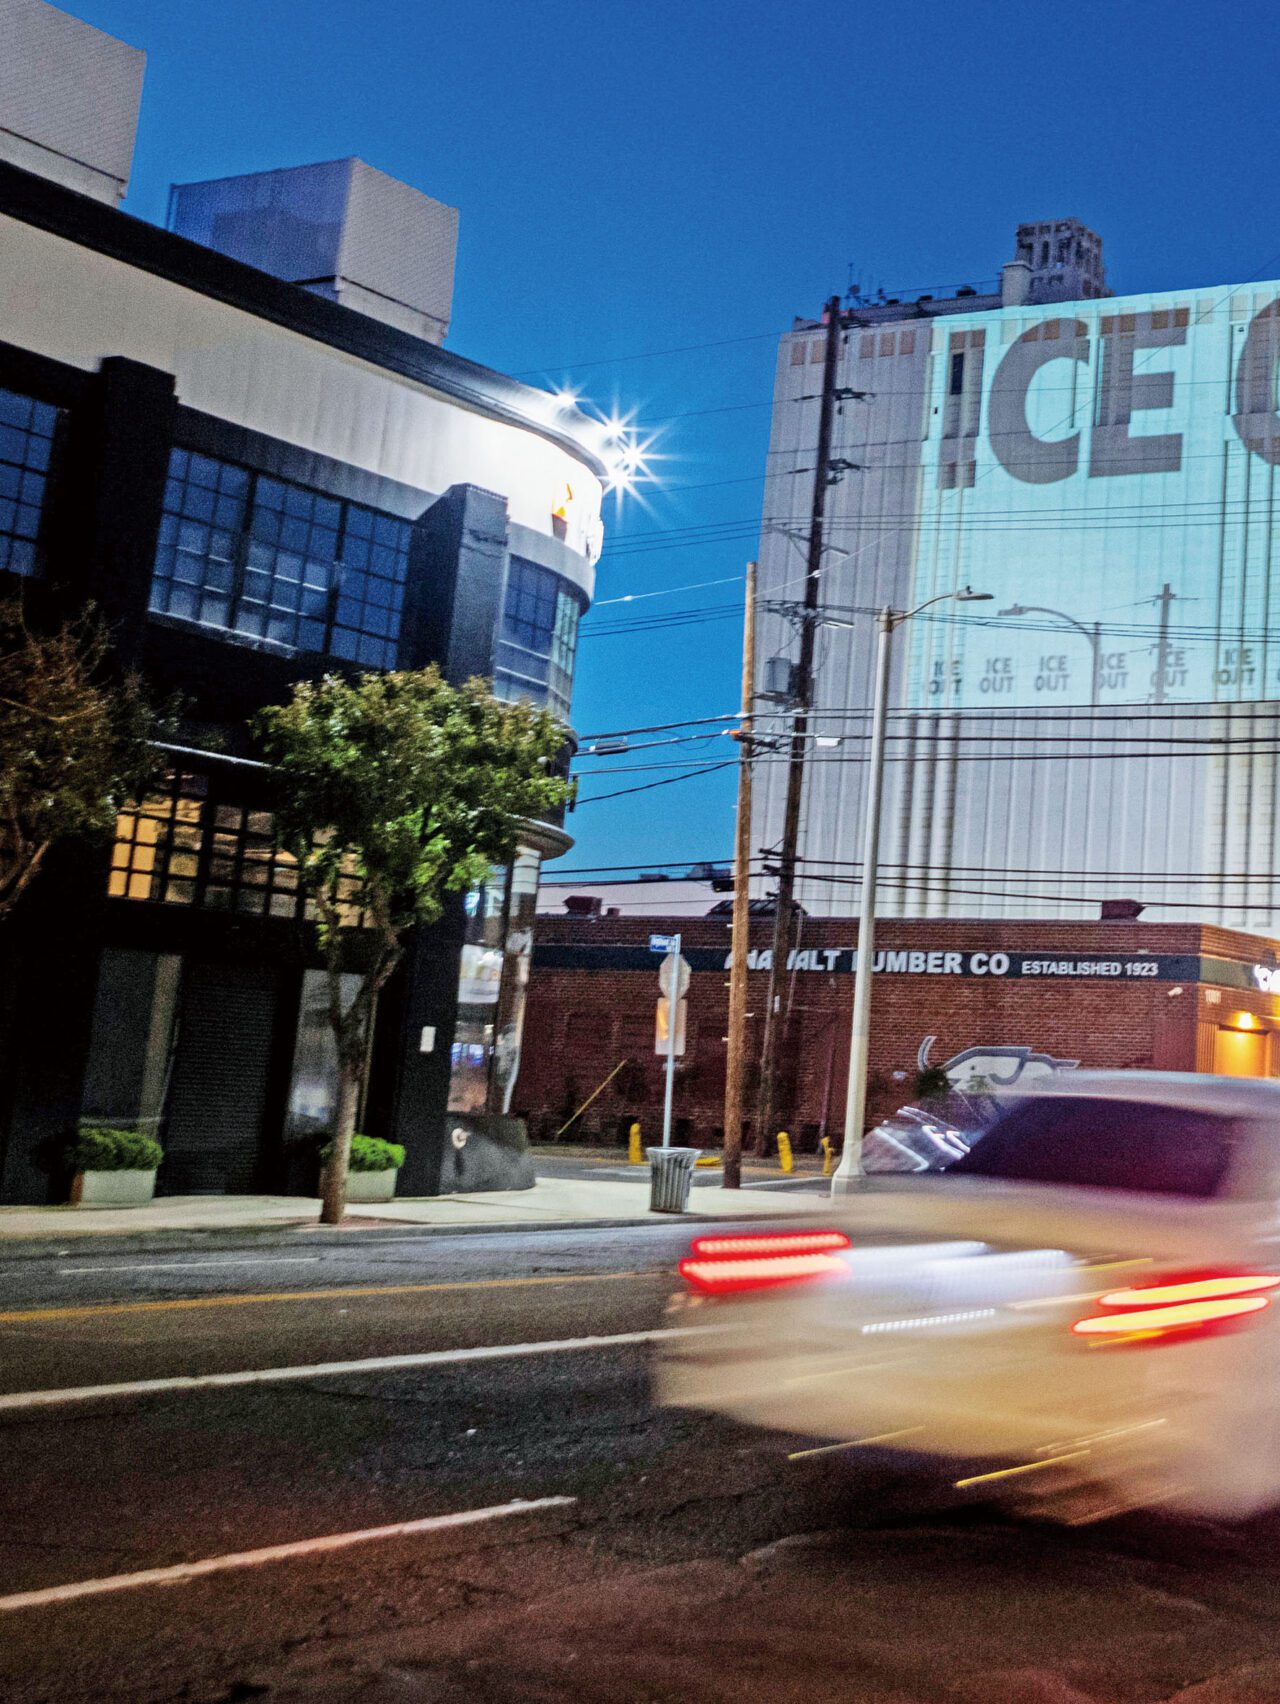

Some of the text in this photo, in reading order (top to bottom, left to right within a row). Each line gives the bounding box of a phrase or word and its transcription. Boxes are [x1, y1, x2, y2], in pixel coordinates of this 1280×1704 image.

[938, 306, 1191, 488] ICE
[986, 657, 1012, 675] ICE
[1040, 655, 1068, 673] ICE
[1100, 653, 1127, 670] ICE
[1160, 651, 1186, 668] CE
[979, 676, 1014, 694] OUT
[1034, 673, 1071, 692] OUT
[970, 952, 1010, 975] CO
[1021, 960, 1122, 976] ESTABLISHED
[1124, 962, 1159, 976] 1923
